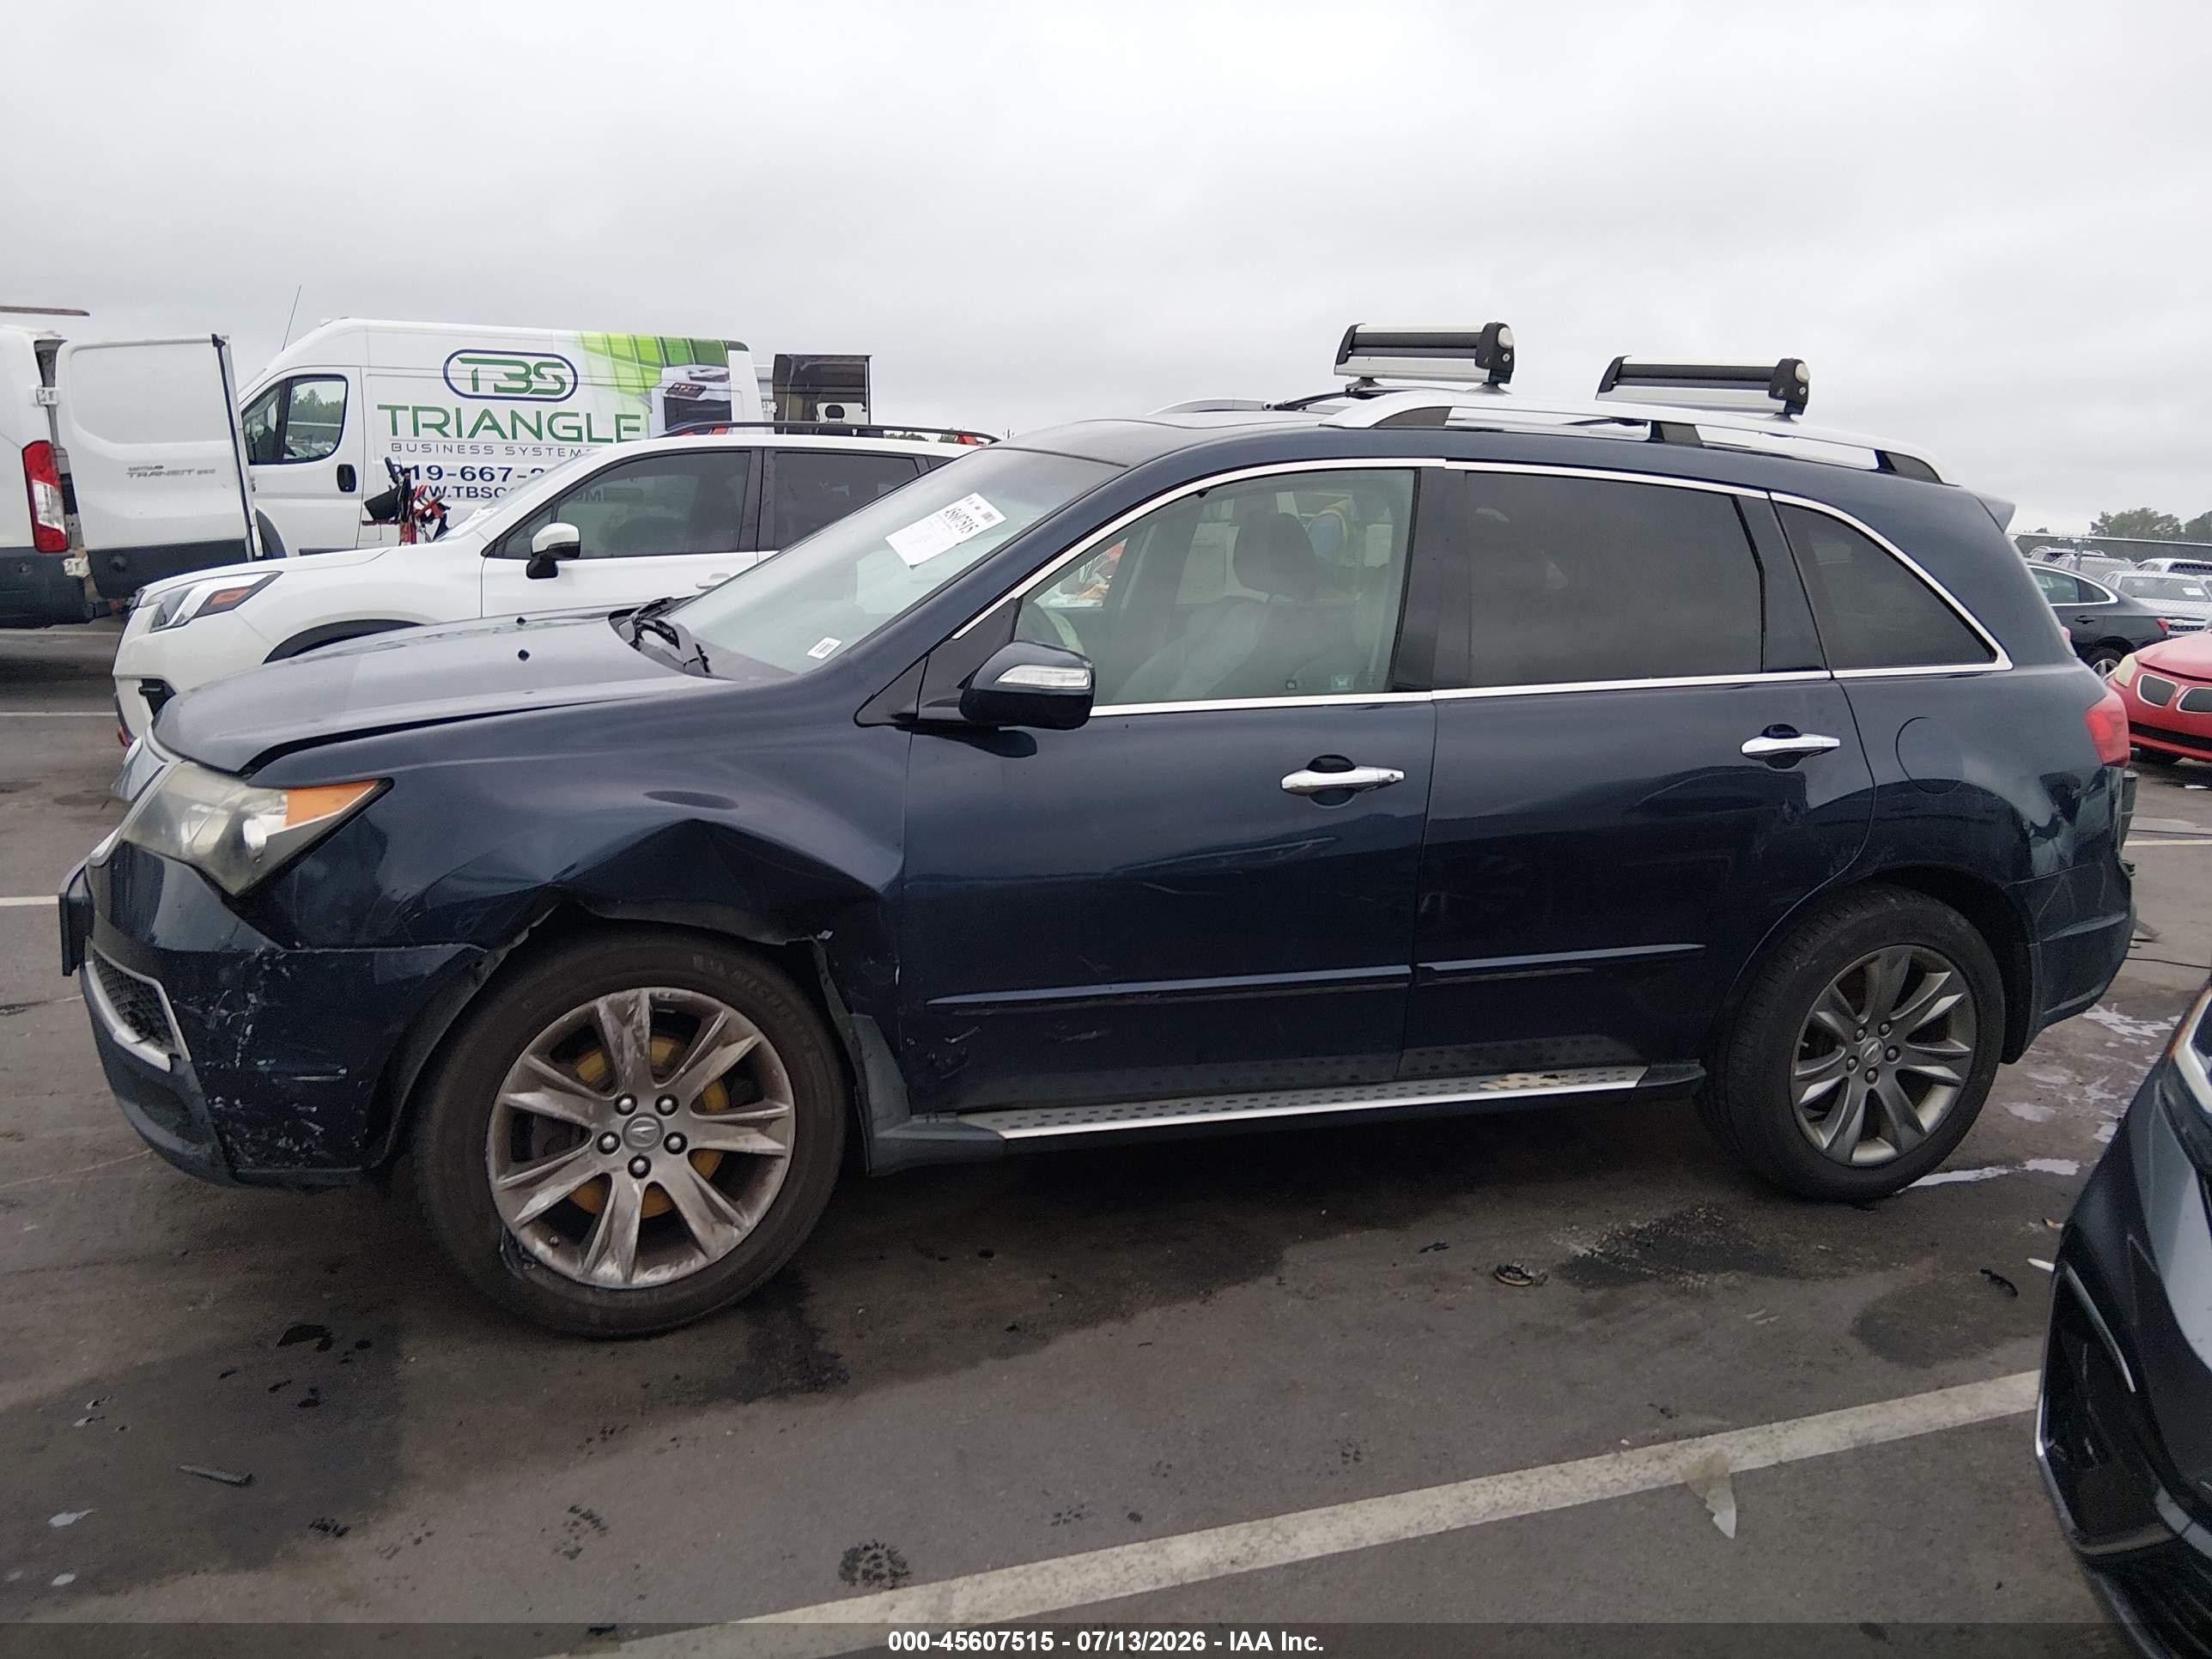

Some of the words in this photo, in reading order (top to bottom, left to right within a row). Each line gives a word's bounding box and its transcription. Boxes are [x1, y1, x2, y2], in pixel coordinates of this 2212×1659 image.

[457, 356, 568, 397] TBS
[377, 404, 641, 443] TRIANGLE
[391, 442, 495, 455] BUSINESS
